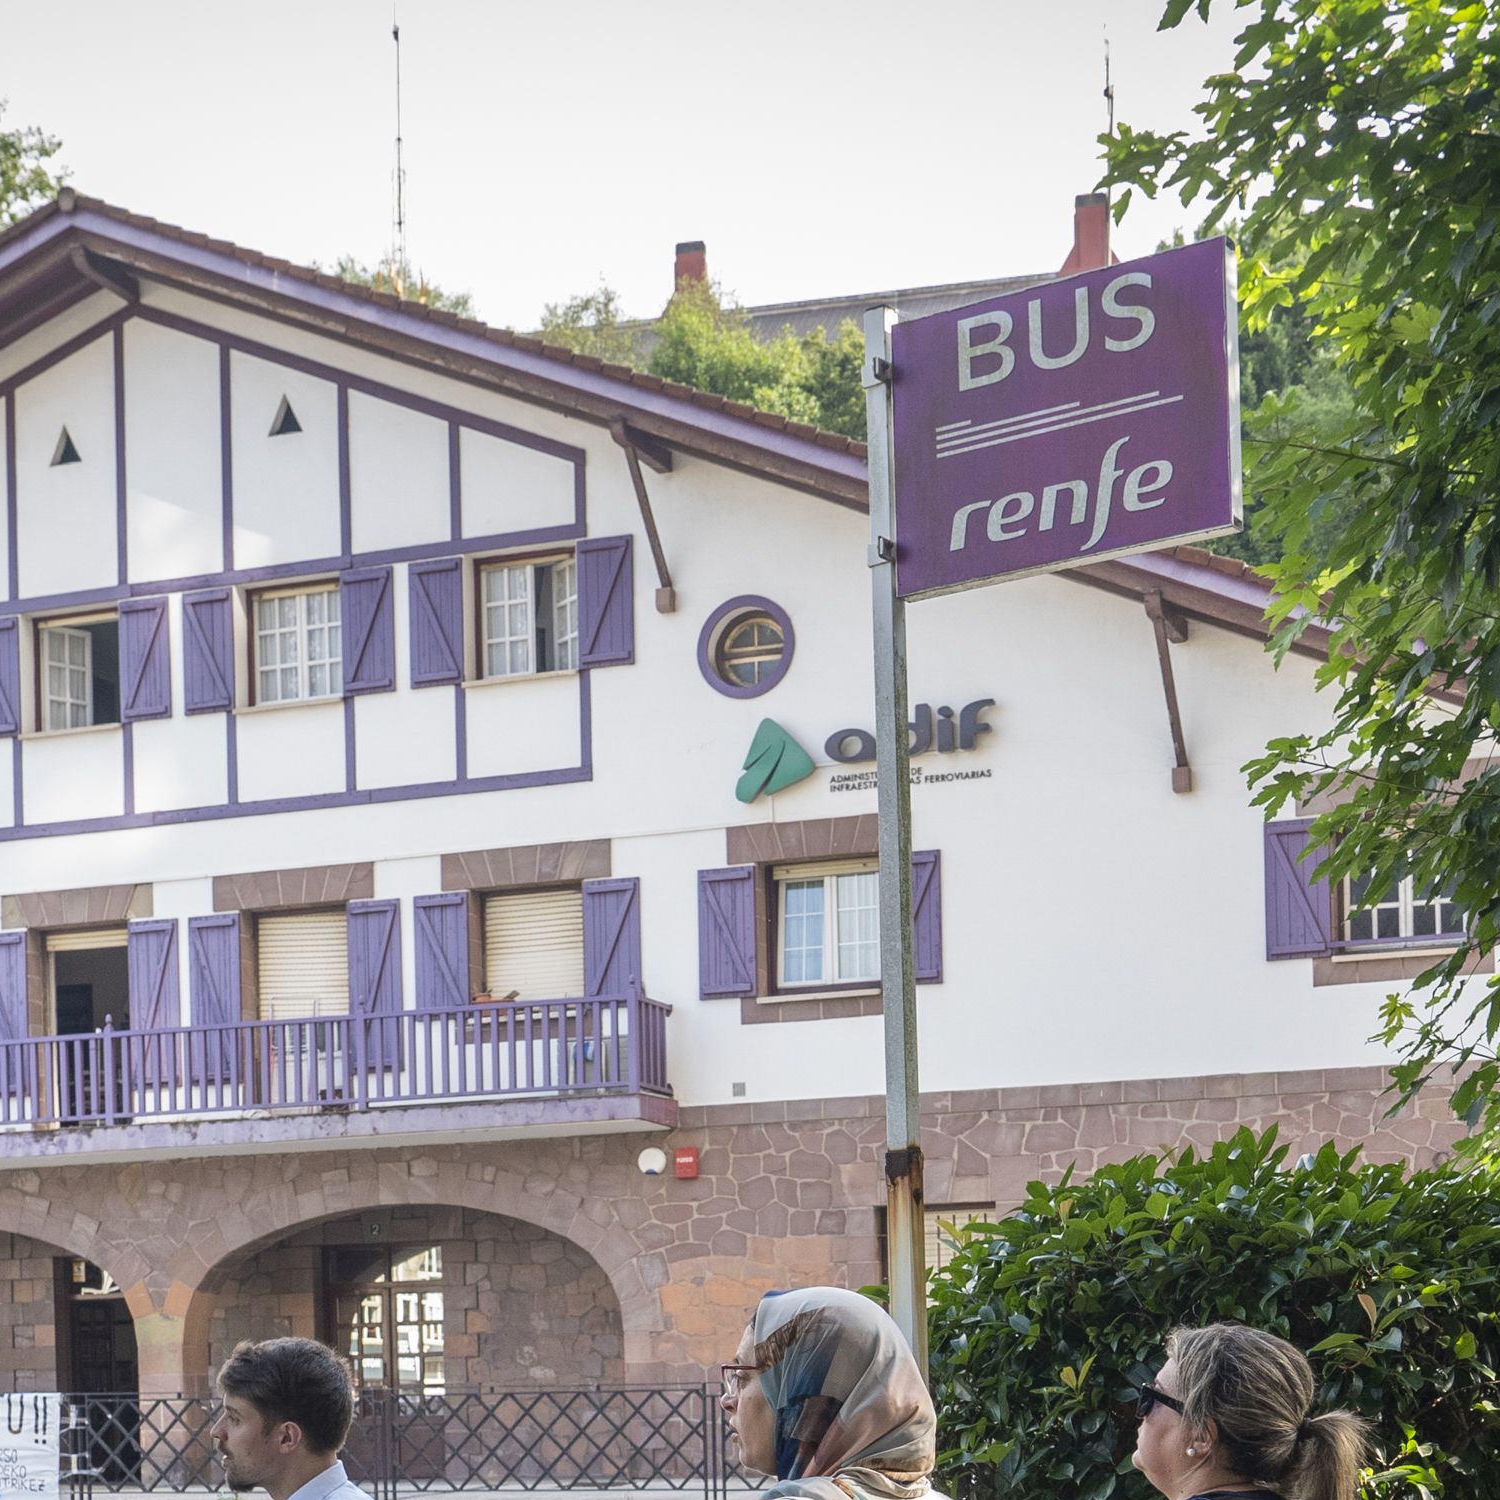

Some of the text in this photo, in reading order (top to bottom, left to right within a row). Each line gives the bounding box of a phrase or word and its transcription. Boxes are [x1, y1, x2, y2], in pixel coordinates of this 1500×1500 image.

[957, 272, 1157, 392] BUS
[949, 436, 1174, 552] renfe
[924, 768, 993, 785] FERROVIARIAS
